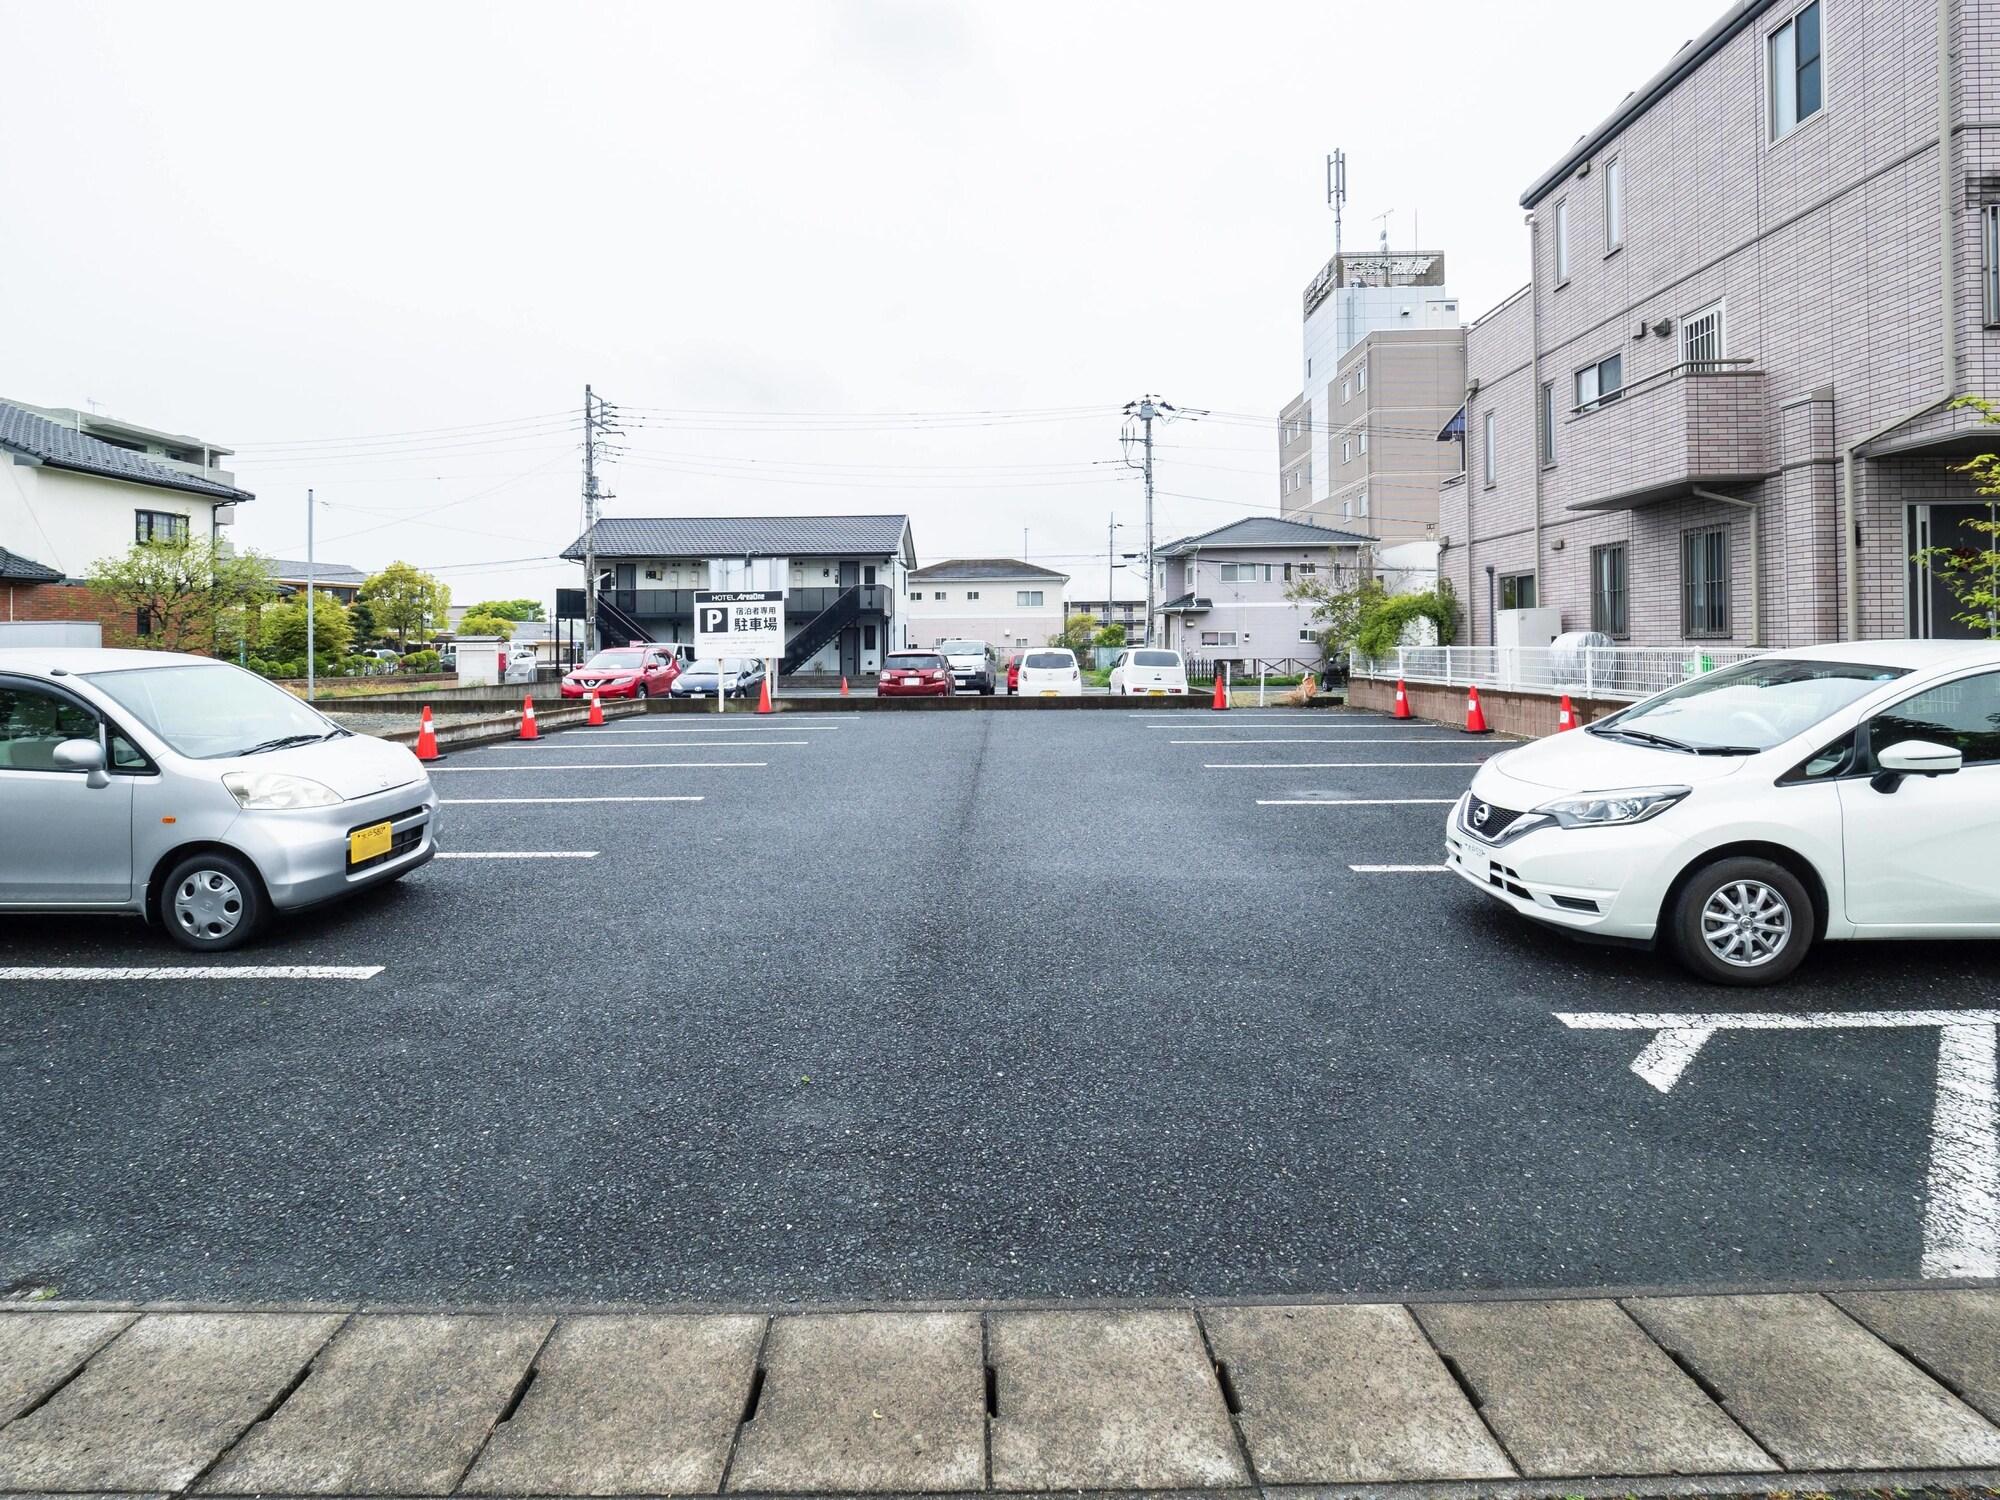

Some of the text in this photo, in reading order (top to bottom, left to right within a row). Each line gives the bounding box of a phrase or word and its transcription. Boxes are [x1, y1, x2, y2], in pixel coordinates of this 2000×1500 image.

[736, 607, 776, 615] 宿泊者専用
[707, 609, 723, 632] P
[734, 617, 777, 632] 駐車場
